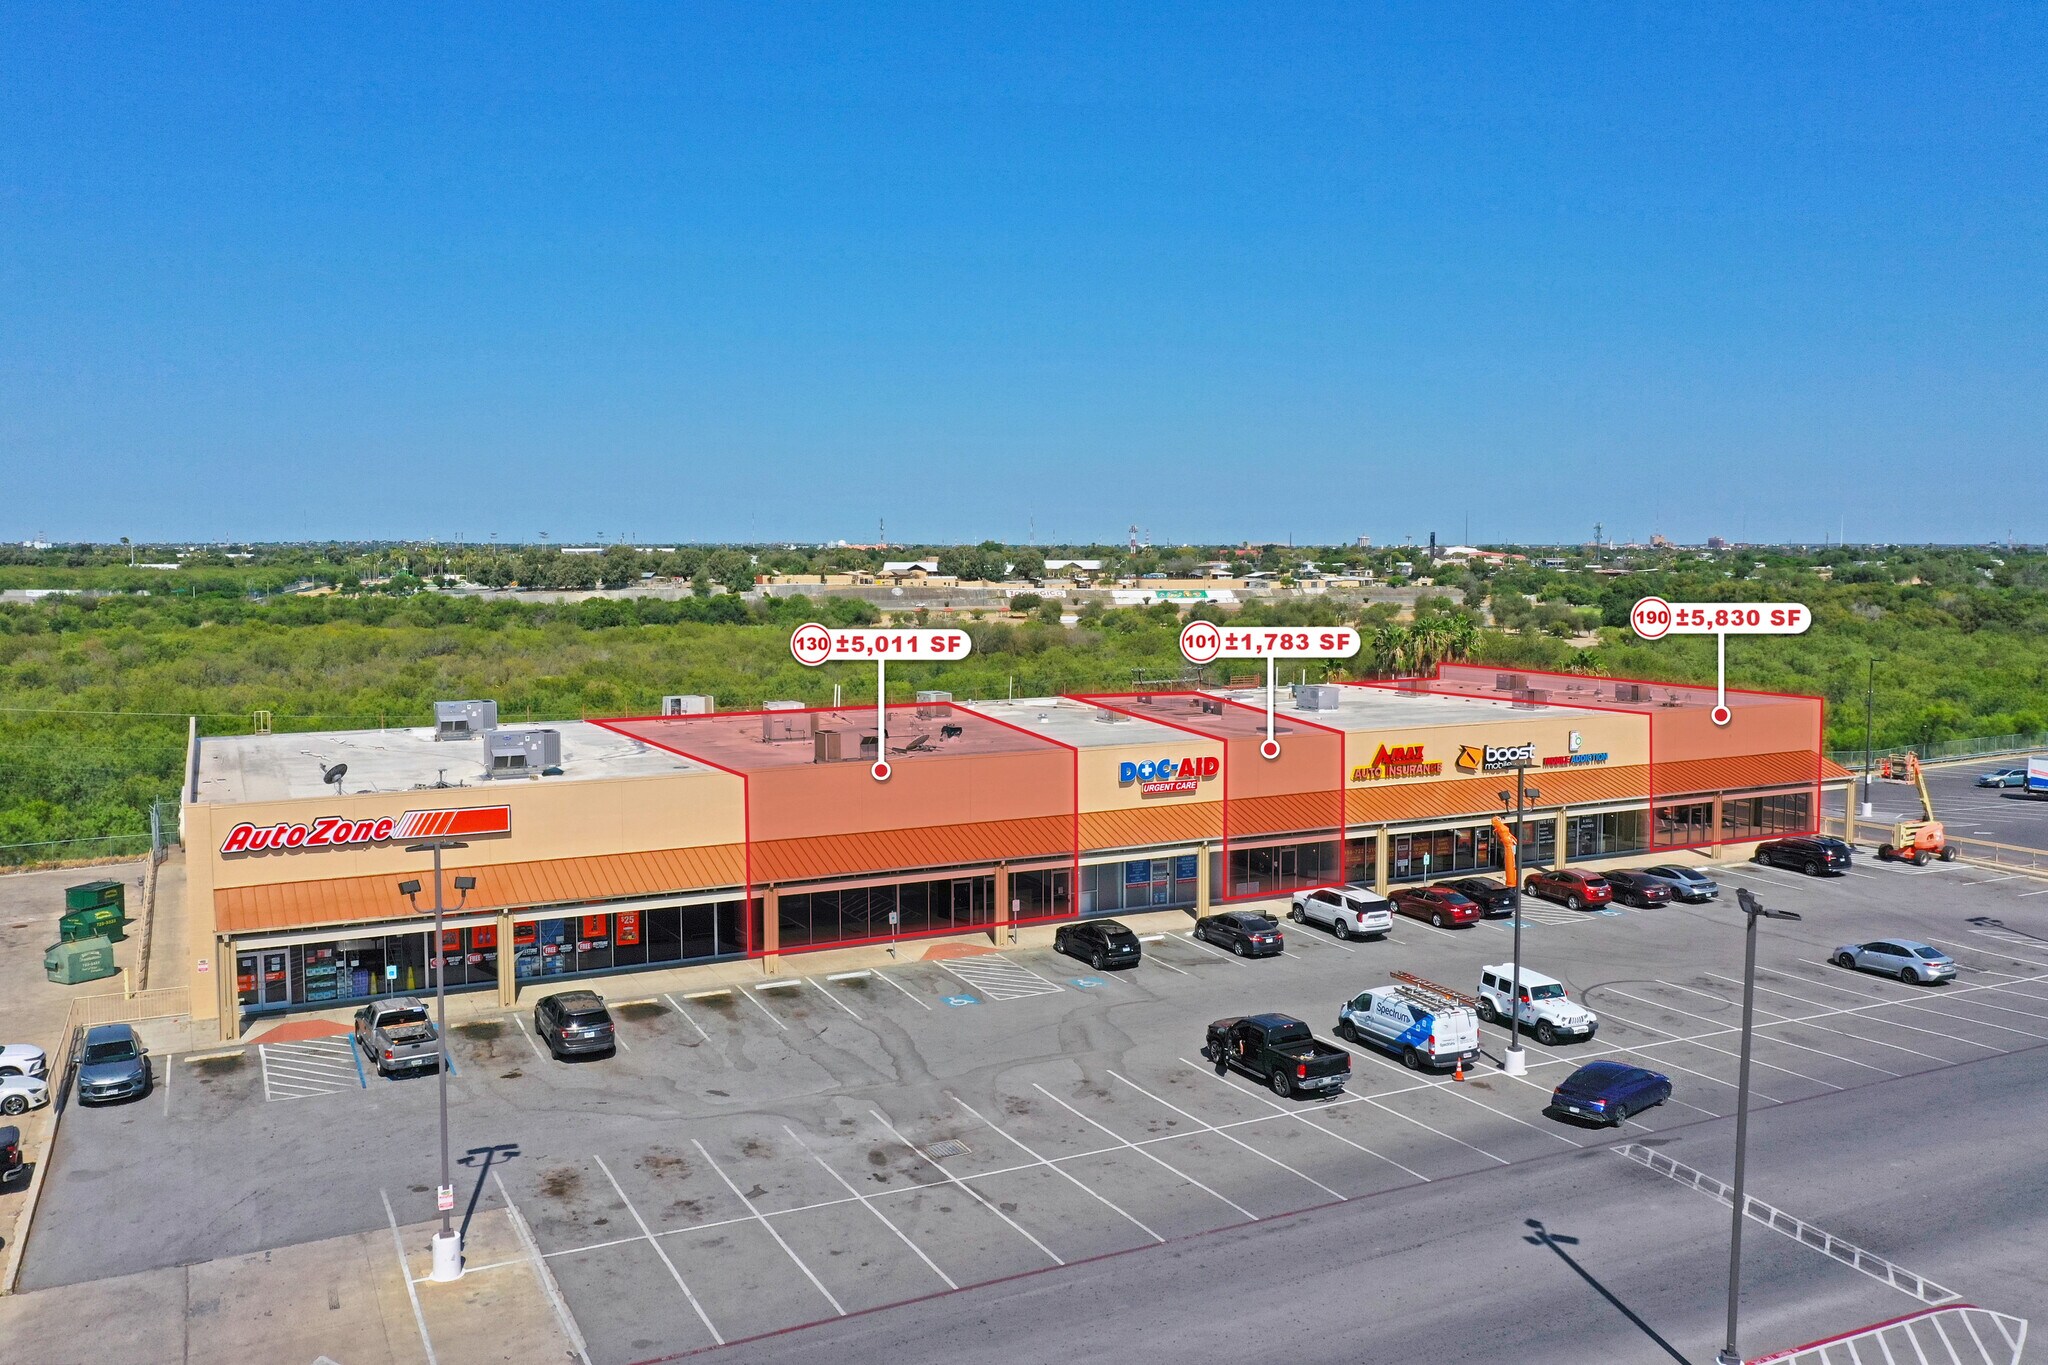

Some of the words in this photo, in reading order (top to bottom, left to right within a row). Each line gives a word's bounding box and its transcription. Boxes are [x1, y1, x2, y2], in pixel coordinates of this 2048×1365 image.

[1485, 743, 1536, 762] boost
[1544, 756, 1571, 766] MOBILE
[1571, 752, 1609, 764] ADDICTION
[1119, 756, 1220, 782] DOC-AID
[1354, 766, 1382, 779] AUTO
[1386, 762, 1443, 778] INSURANCE
[1484, 760, 1513, 770] mobile
[1143, 782, 1175, 793] URGENT
[1176, 781, 1197, 790] CARE
[222, 816, 395, 852] AutoZone
[621, 915, 635, 925] $25
[1376, 1002, 1411, 1023] Spectrum
